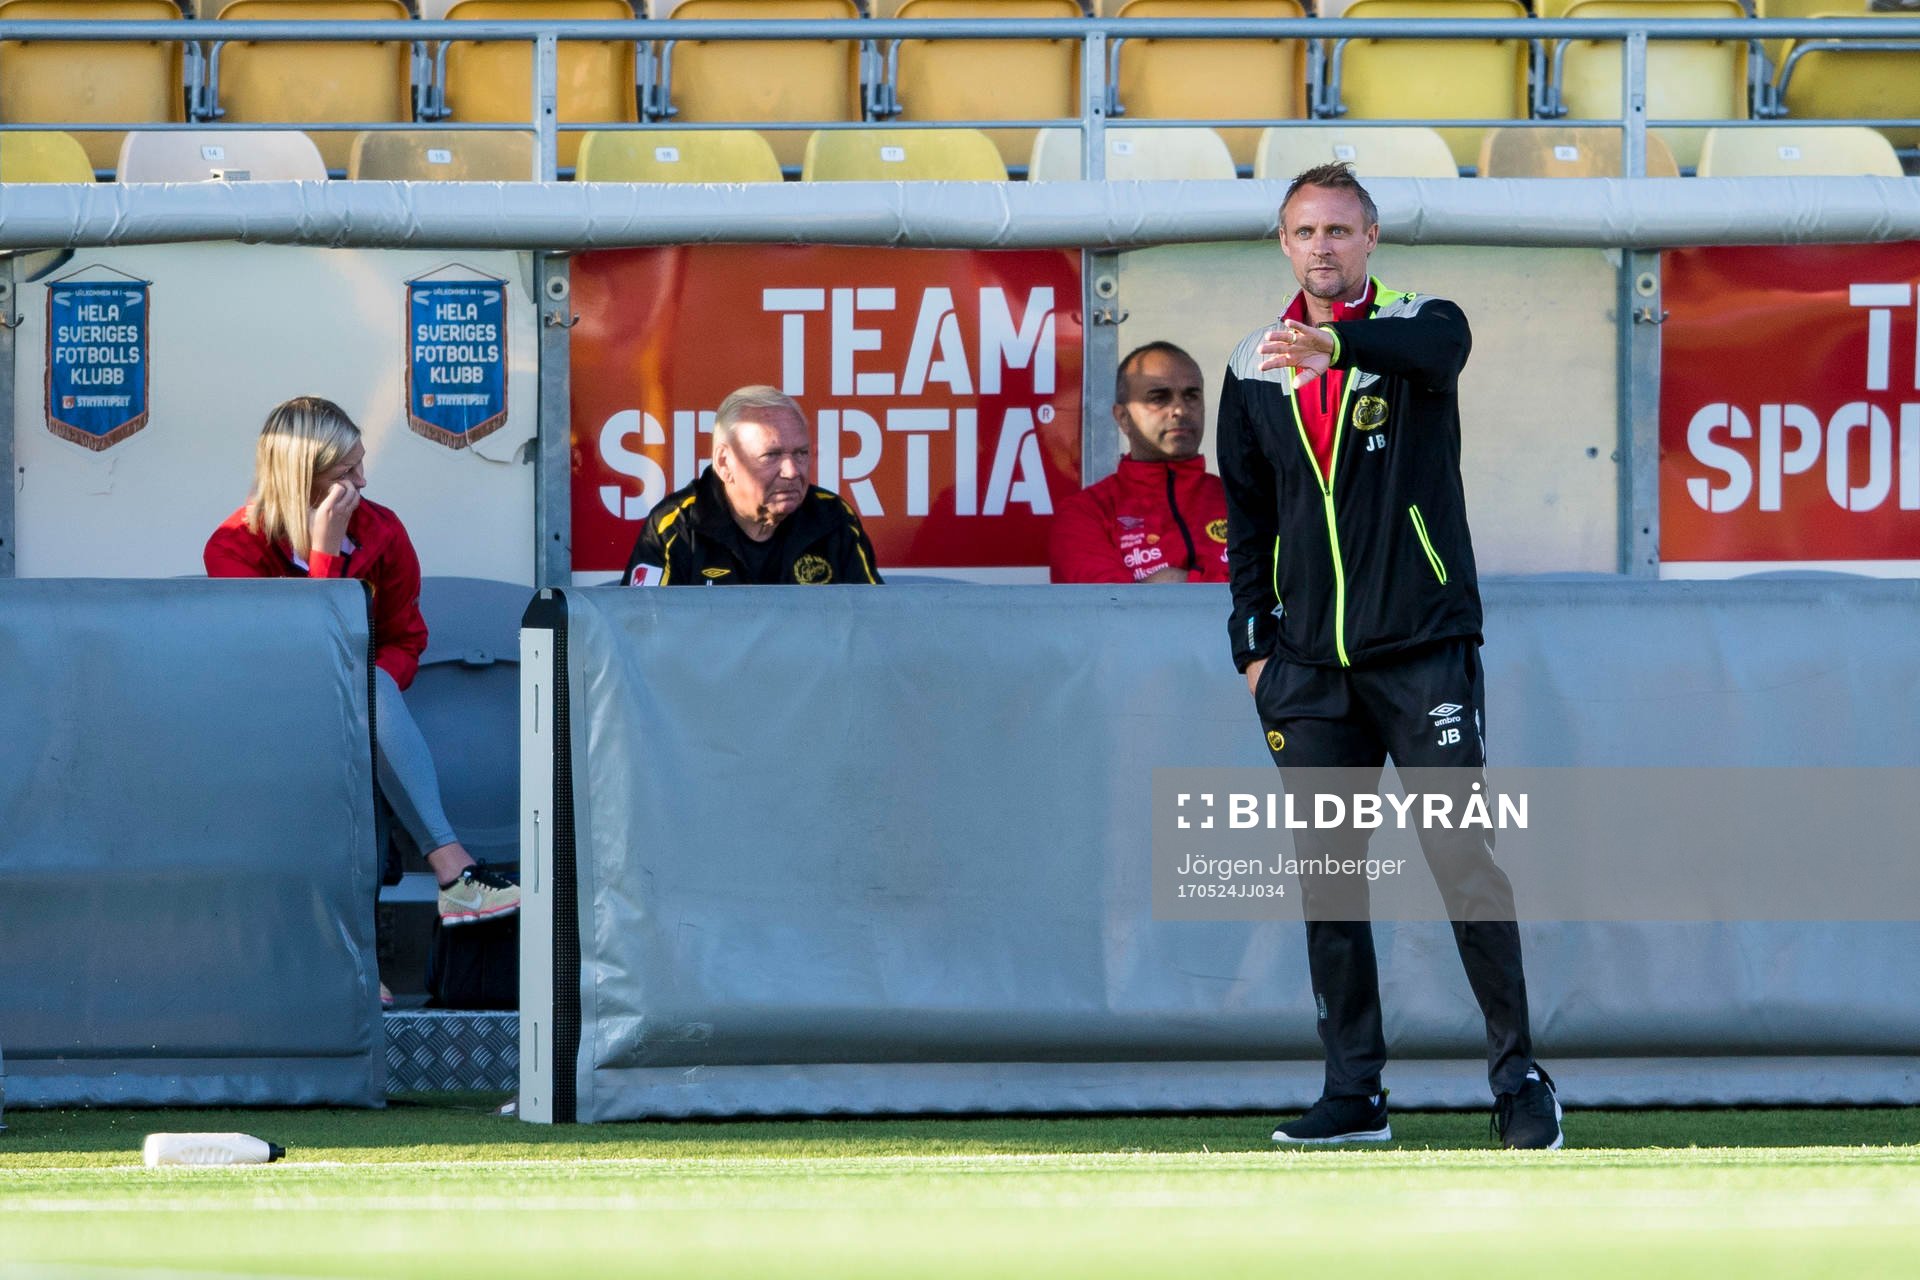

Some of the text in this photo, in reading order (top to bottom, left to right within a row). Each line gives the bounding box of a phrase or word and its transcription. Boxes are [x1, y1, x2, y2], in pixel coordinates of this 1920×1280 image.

[78, 304, 120, 322] HELA
[436, 303, 479, 321] HELA
[58, 325, 138, 342] SVERIGES
[417, 324, 497, 342] SVERIGES
[763, 287, 1055, 396] TEAM
[1848, 283, 1920, 391] T
[56, 346, 140, 364] FOTBOLLS
[415, 345, 499, 363] FOTBOLLS
[70, 367, 125, 385] KLUBB
[430, 366, 484, 384] KLUBB
[1366, 433, 1386, 452] JB
[599, 407, 1054, 521] SPRTIA
[1123, 547, 1162, 568] ellos
[1434, 715, 1461, 727] umbro
[1437, 728, 1461, 746] JB
